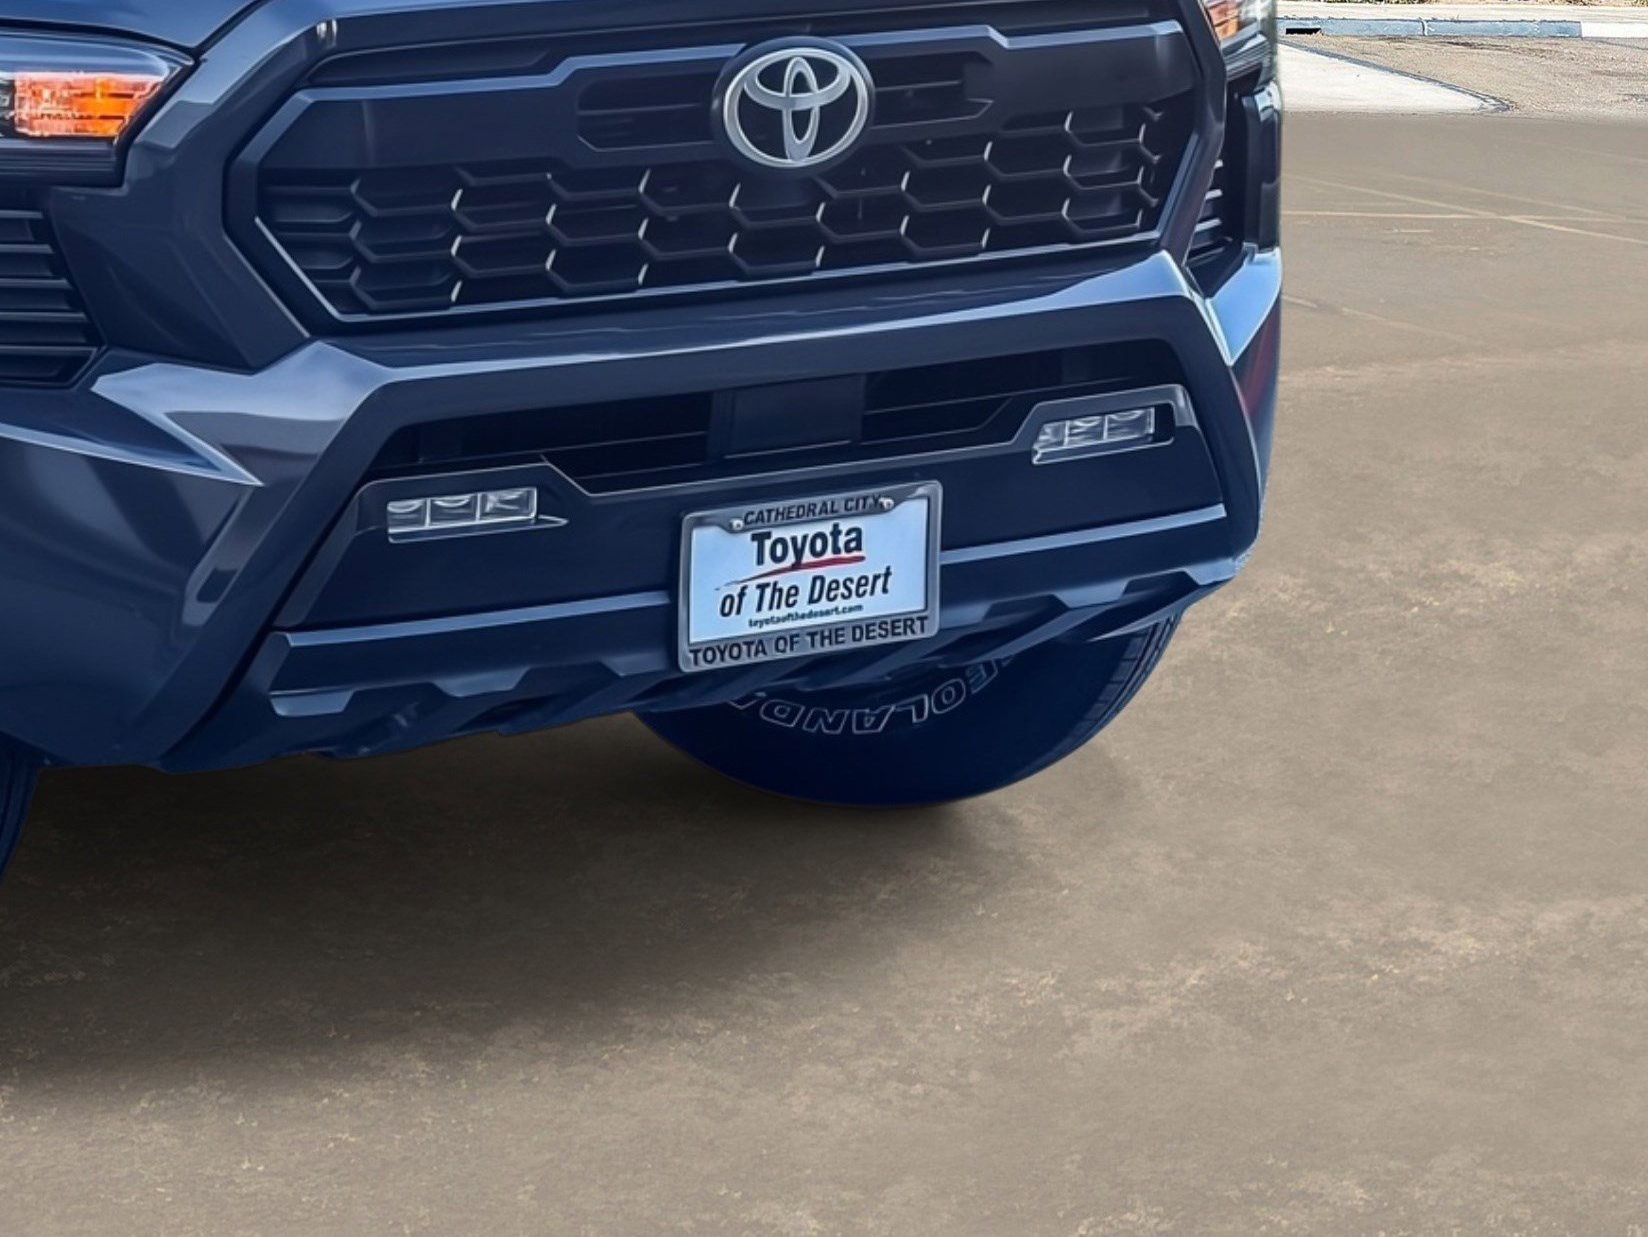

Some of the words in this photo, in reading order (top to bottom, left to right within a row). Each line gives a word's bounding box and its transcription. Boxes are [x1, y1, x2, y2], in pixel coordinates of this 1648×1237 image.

[743, 500, 839, 525] CATHEDRAL
[844, 495, 882, 512] CITY
[751, 522, 864, 569] Toyota
[720, 585, 748, 618] of
[755, 580, 800, 613] The
[807, 565, 892, 606] Desert
[689, 638, 768, 666] TOYOTA
[774, 634, 801, 653] OF
[806, 627, 846, 649] THE
[851, 615, 930, 643] DESERT
[730, 658, 1014, 734] EOLAND
